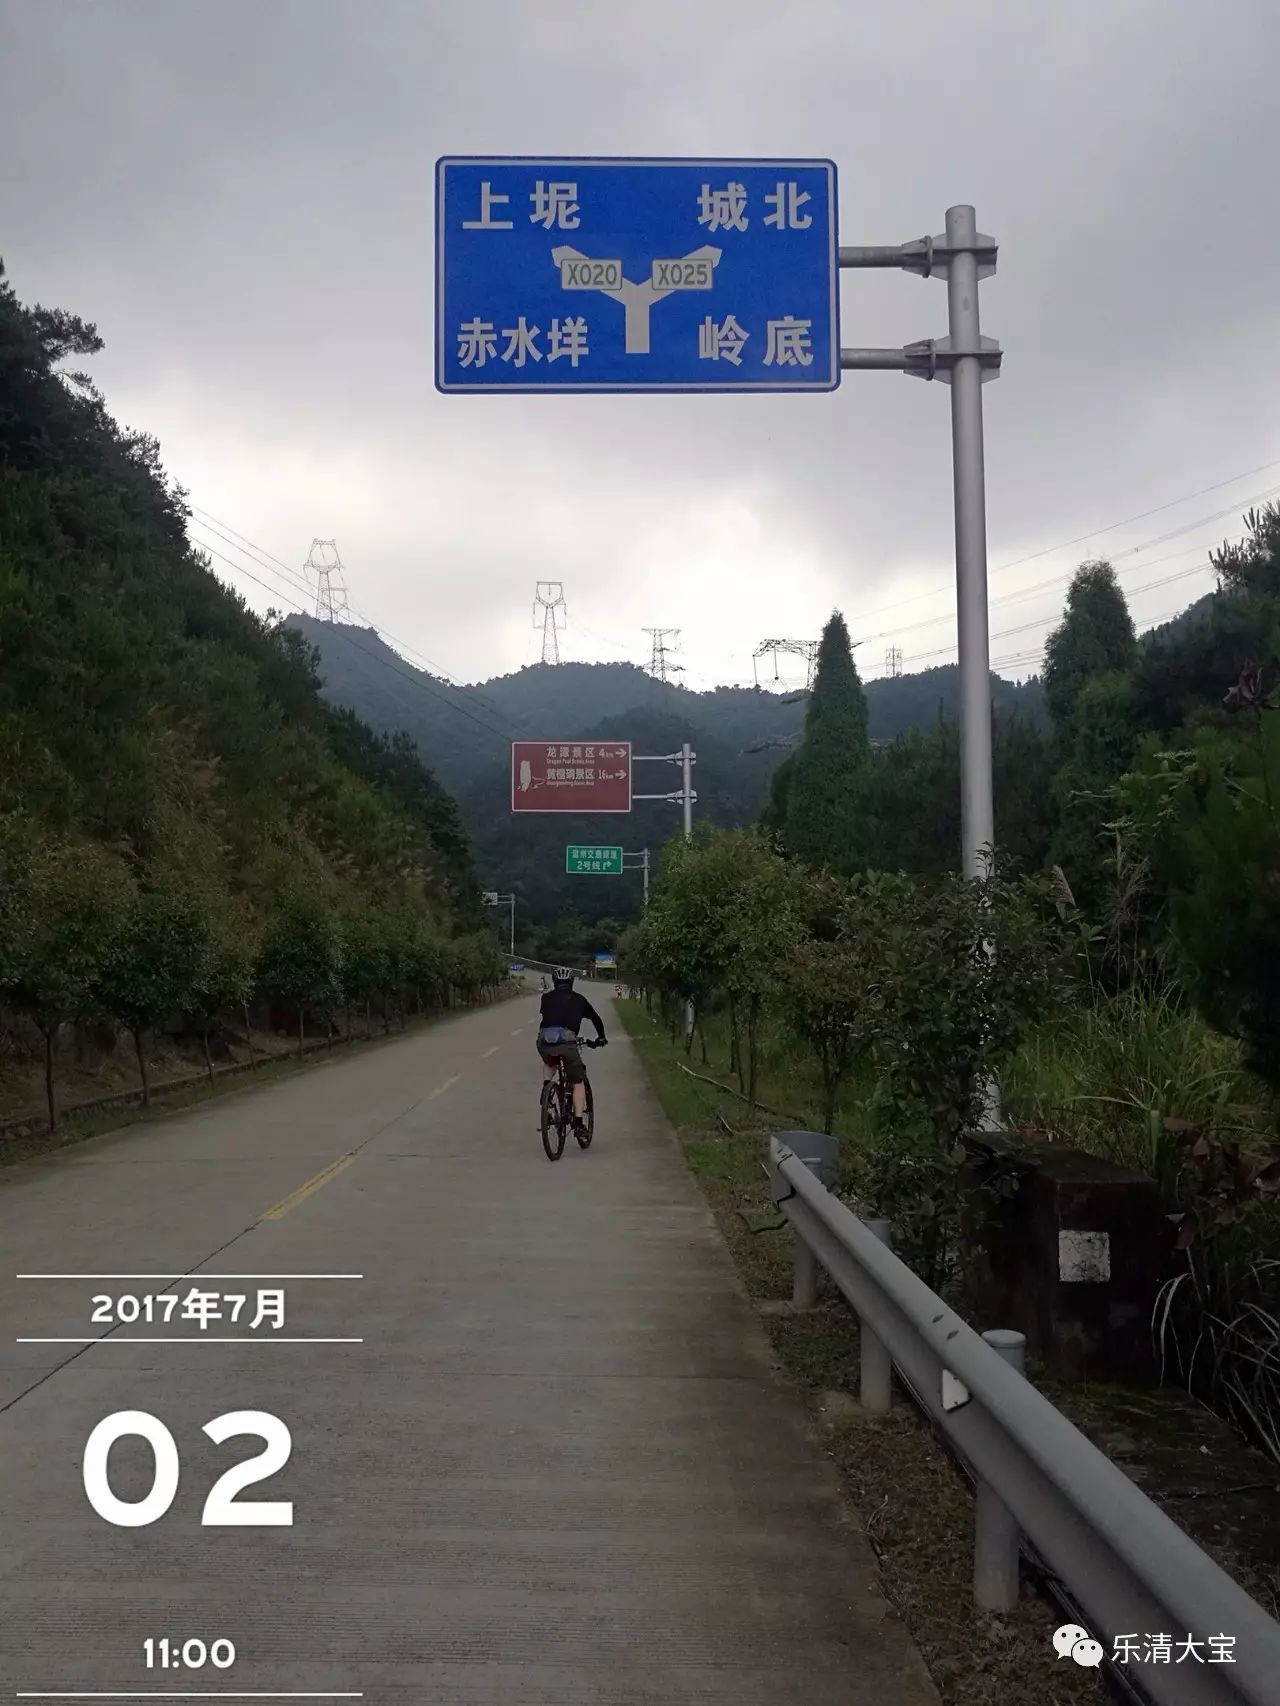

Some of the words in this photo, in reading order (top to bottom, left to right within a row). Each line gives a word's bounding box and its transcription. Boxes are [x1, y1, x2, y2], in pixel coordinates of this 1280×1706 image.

[462, 181, 581, 230] 上坭
[697, 182, 813, 232] 城北
[567, 263, 618, 286] X020
[657, 263, 709, 286] X025
[457, 316, 589, 368] 赤水垟
[698, 315, 814, 367] 岭底
